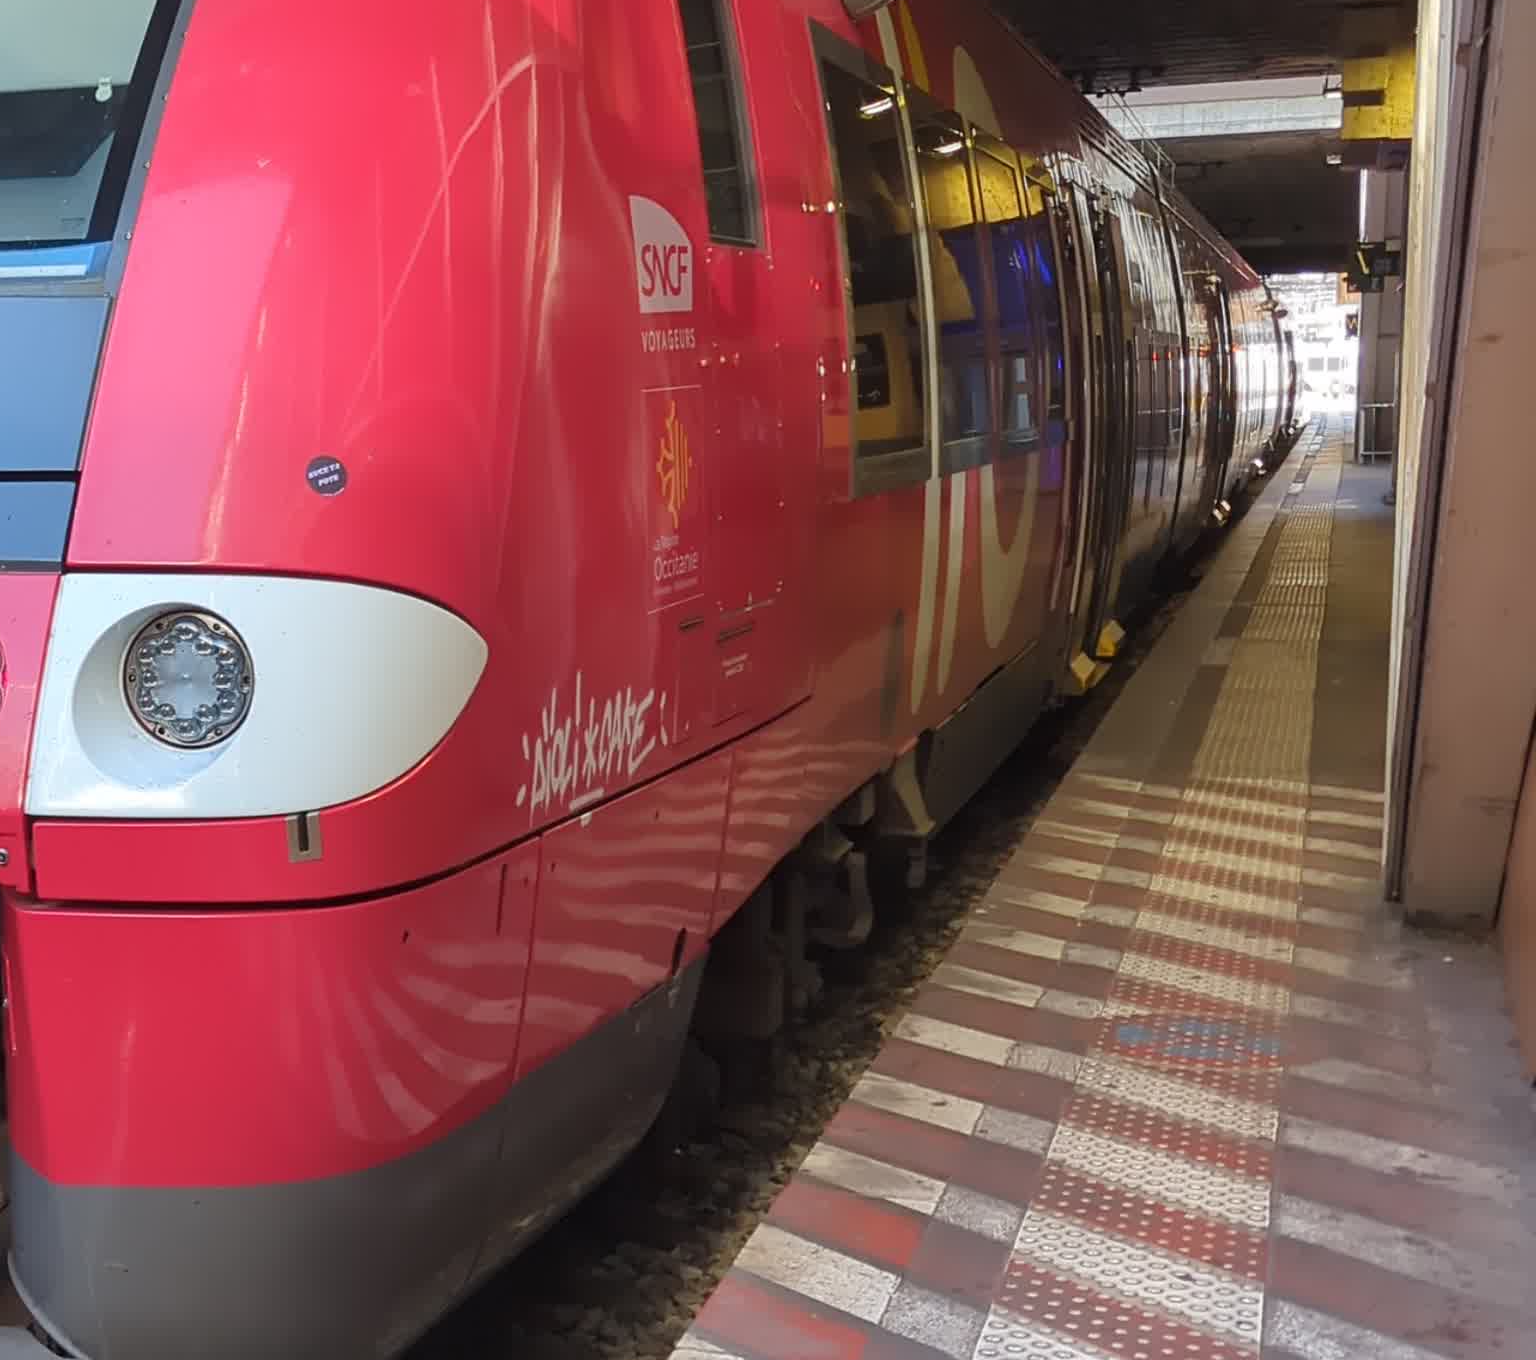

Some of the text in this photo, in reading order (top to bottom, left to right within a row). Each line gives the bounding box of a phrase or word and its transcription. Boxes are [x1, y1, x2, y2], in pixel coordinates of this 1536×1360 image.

[640, 243, 689, 297] SNCF
[640, 327, 696, 353] VOYAGEURS
[653, 546, 700, 582] Occitanie
